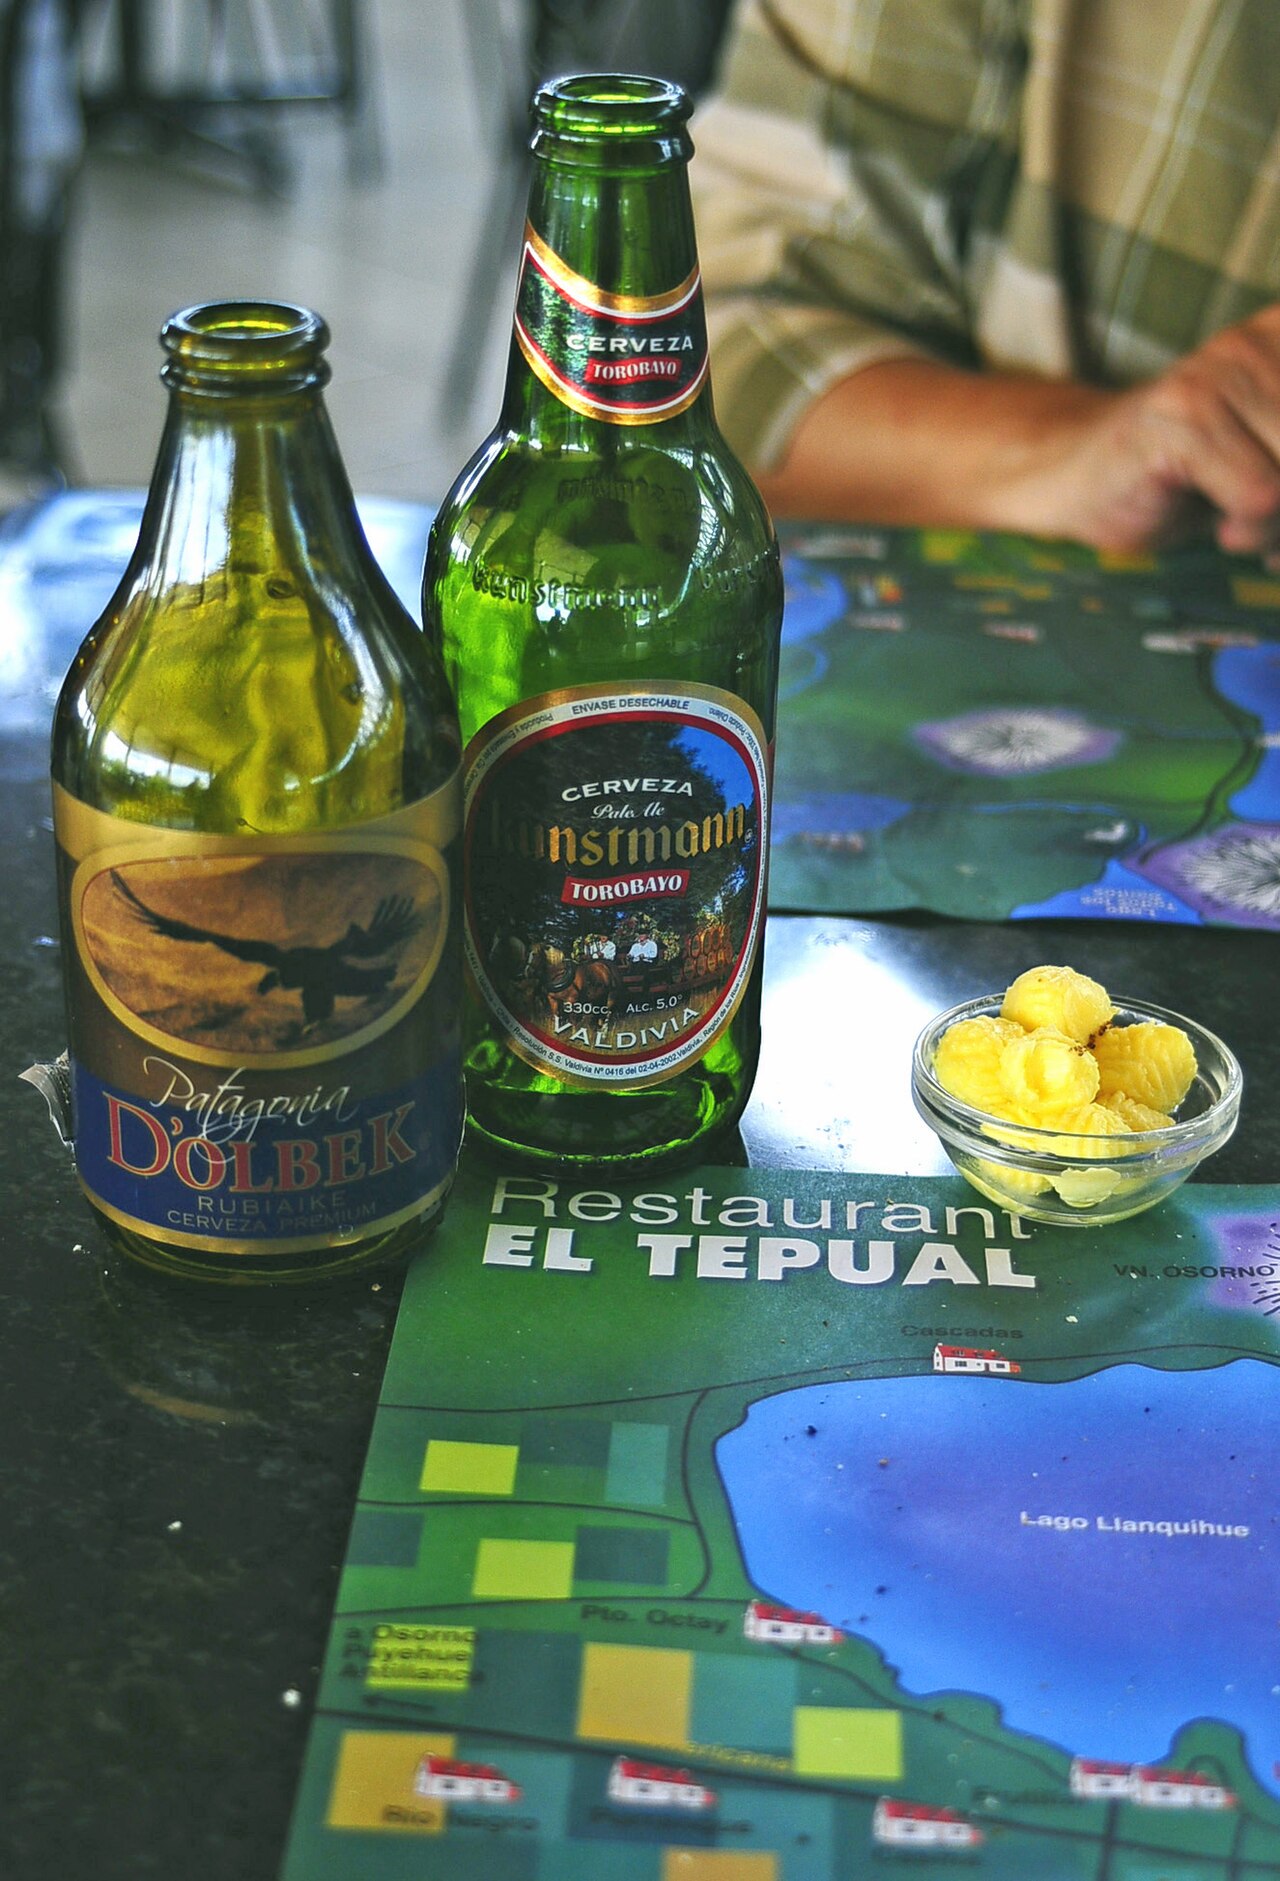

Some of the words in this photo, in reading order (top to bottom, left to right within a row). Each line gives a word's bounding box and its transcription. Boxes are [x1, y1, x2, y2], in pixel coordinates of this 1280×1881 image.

[566, 334, 693, 352] CERVEZA
[593, 361, 677, 379] TOROBAYO
[572, 699, 617, 715] ENVASE
[619, 698, 691, 710] DESECHABLE
[562, 778, 693, 802] CERVEZA
[591, 804, 635, 819] Pale
[571, 874, 682, 901] TOROBAYO
[553, 1007, 700, 1050] VALDIVIA
[513, 1027, 548, 1056] Resolución
[565, 1060, 592, 1074] Valdivia
[624, 1066, 637, 1075] del
[143, 1056, 361, 1150] Patagonia
[102, 1091, 418, 1193] D'OLBEK
[198, 1190, 346, 1215] RUBIAIKE
[490, 1177, 1031, 1239] Restaurant
[167, 1210, 266, 1232] CERVEZA
[278, 1202, 377, 1231] PREMIUM
[482, 1223, 594, 1272] EL
[636, 1233, 1036, 1288] TEPUAL
[1113, 1264, 1156, 1278] VN.
[1162, 1264, 1275, 1279] OSORNO
[900, 1324, 1024, 1340] Cascadas
[1019, 1511, 1089, 1530] Lago
[1096, 1516, 1250, 1537] Llanquihue
[646, 1607, 730, 1634] Octay
